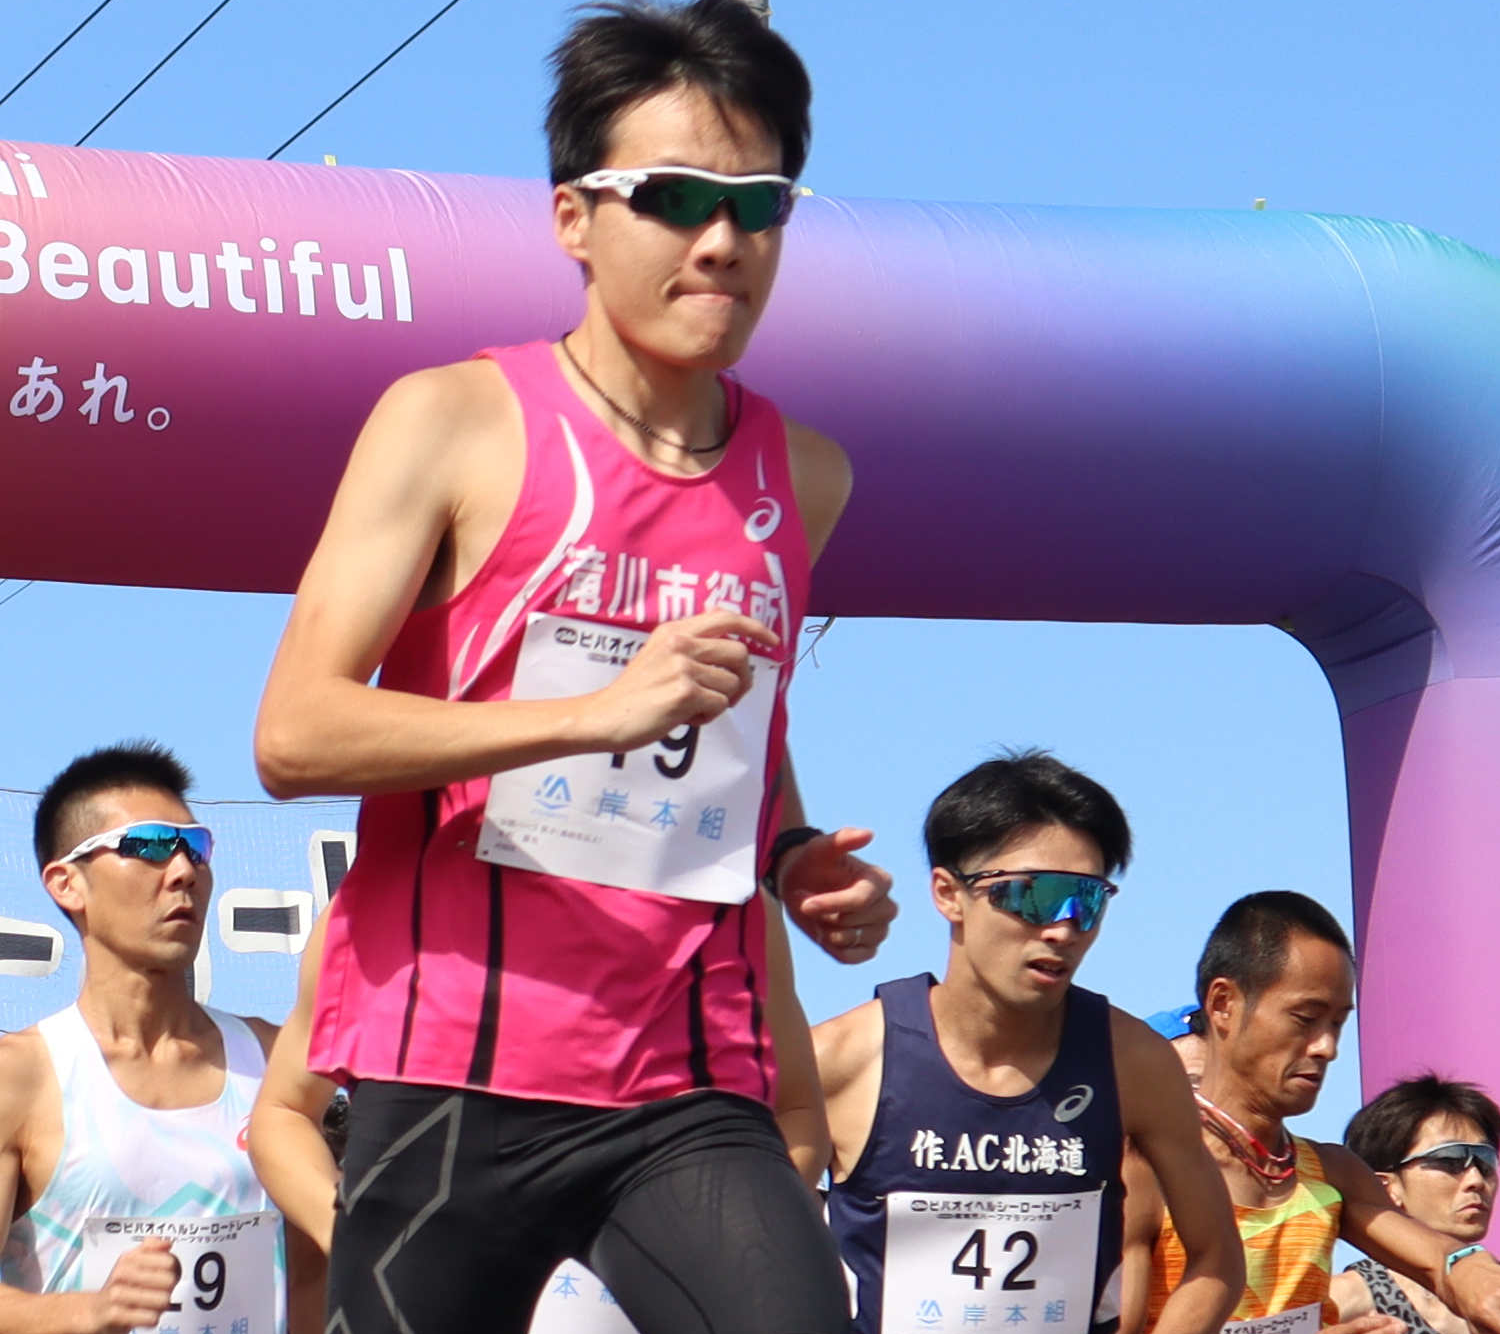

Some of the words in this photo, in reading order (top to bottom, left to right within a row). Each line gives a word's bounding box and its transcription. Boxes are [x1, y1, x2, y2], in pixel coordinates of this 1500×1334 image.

[610, 723, 700, 780] 9
[598, 788, 726, 841] 岸本組
[951, 1229, 1038, 1291] 42
[963, 1299, 1066, 1327] 岸本組
